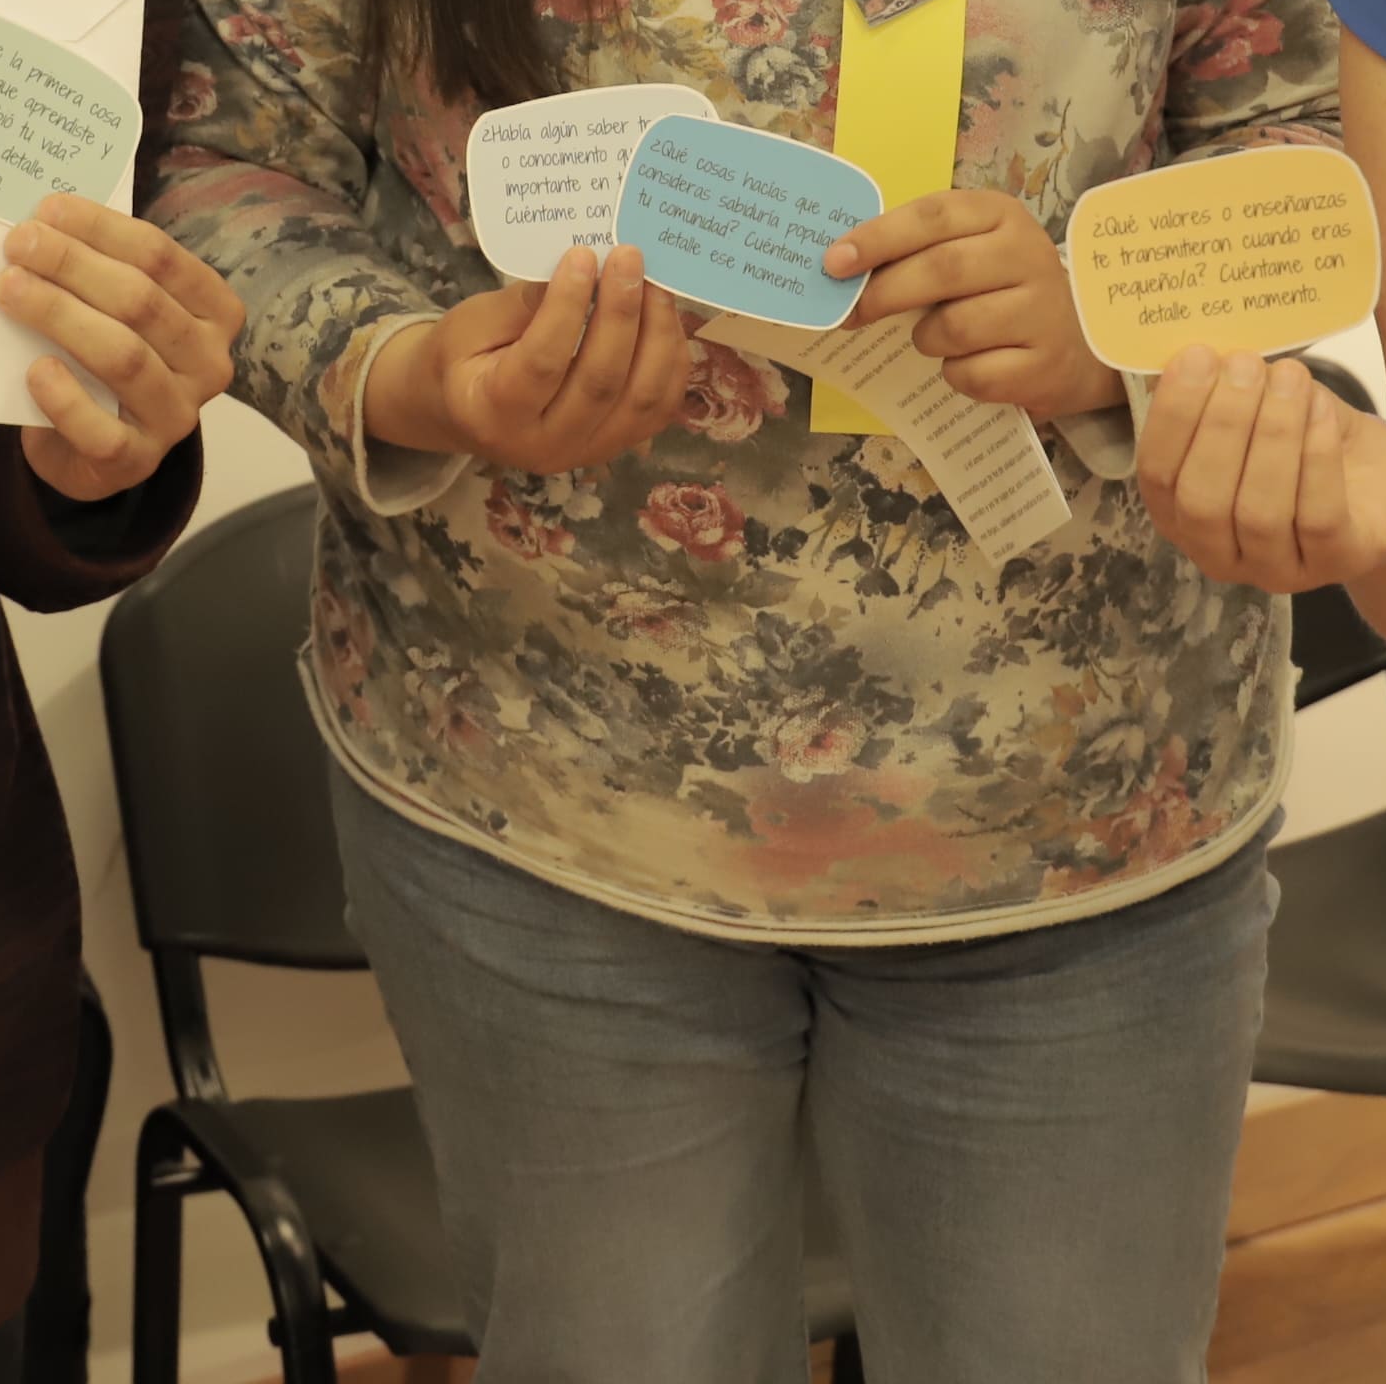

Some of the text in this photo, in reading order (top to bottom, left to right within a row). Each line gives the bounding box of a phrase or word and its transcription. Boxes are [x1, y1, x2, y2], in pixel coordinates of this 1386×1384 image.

[10, 52, 23, 70] la
[25, 66, 83, 107] primera
[89, 103, 122, 129] cosa
[19, 123, 32, 142] tu
[24, 96, 96, 144] aprendiste
[102, 142, 113, 159] y
[540, 121, 578, 144] algún
[586, 118, 629, 138] saber
[1, 146, 44, 180] detalle
[502, 155, 510, 169] o
[519, 147, 607, 168] conocimiento
[505, 174, 581, 201] importante
[591, 177, 610, 191] en
[638, 163, 712, 201] consideras
[718, 193, 779, 230] sabiduría
[696, 156, 736, 182] cosas
[743, 171, 787, 202] hacías
[795, 196, 822, 217] que
[828, 204, 863, 227] ahor
[505, 203, 611, 226] Cuéntame con
[638, 190, 653, 209] tu
[745, 227, 813, 270] Cuéntame
[1149, 207, 1212, 232] valores
[1222, 206, 1231, 221] o
[1243, 191, 1347, 218] enseñanzas
[658, 227, 701, 256] detalle
[710, 249, 736, 270] ese
[1093, 221, 1352, 270] te transmitieron cuando eras
[1219, 256, 1303, 283] Cuéntame
[1315, 253, 1345, 271] con
[1139, 299, 1191, 325] detalle
[1202, 295, 1233, 315] ese
